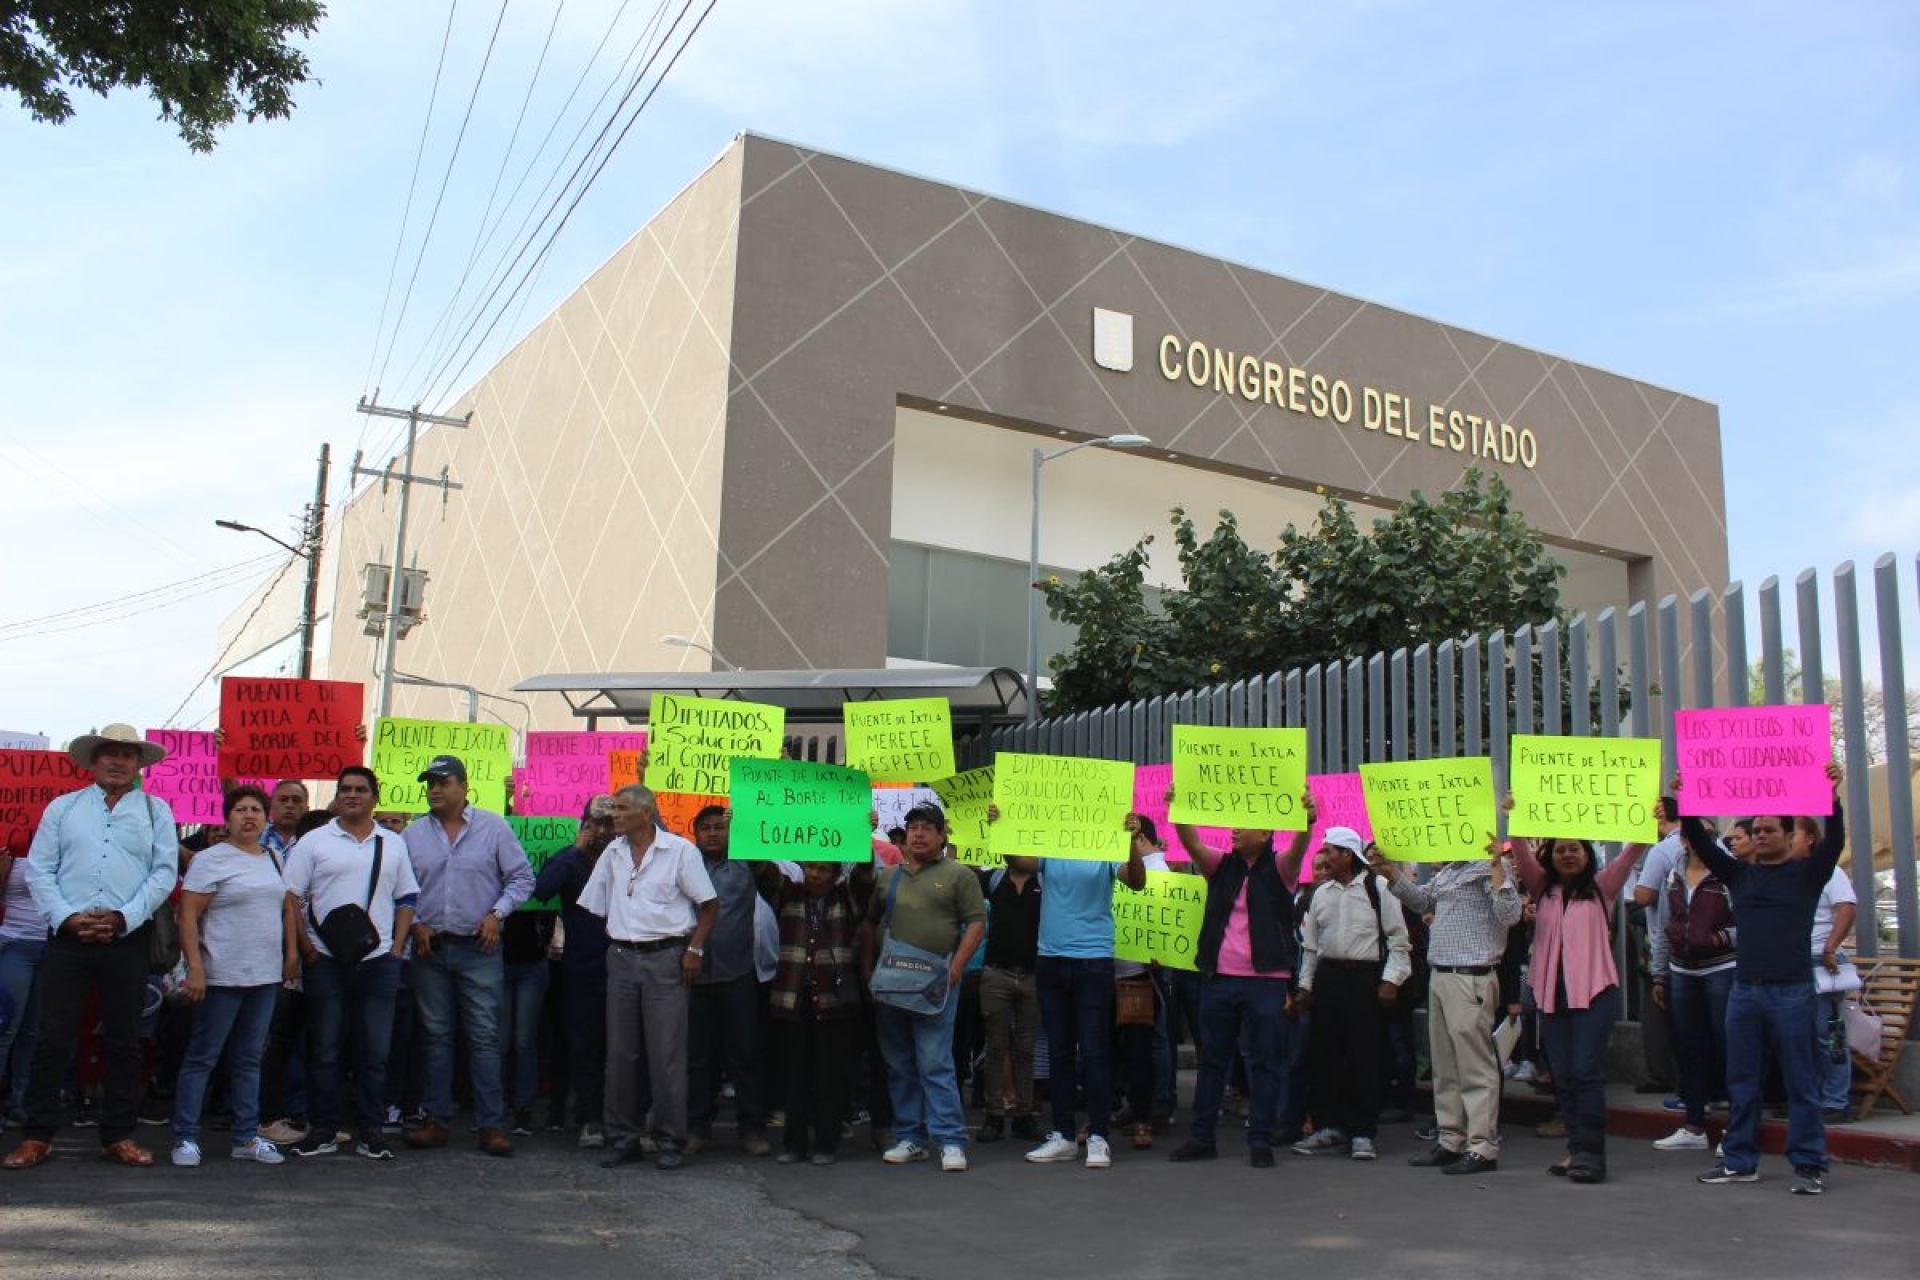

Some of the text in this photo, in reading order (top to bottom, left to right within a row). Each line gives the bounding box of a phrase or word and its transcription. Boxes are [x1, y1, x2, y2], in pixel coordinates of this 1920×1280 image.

[1159, 334, 1537, 468] CONGRESO DEL ESTADO
[236, 683, 304, 701] PUENTE
[240, 709, 332, 727] IXTLA AL
[851, 711, 892, 727] PUENTE
[1684, 717, 1711, 740] LOS
[1792, 716, 1815, 737] NO
[249, 731, 346, 750] BORDE DEL
[379, 721, 436, 748] PUENTE
[866, 730, 932, 750] MERECE
[529, 736, 578, 756] PUENTE
[586, 736, 606, 756] DE
[655, 745, 670, 767] al
[1178, 739, 1223, 756] PUENTE
[1250, 742, 1296, 758] IXTLA
[235, 754, 343, 775] COLAPSO
[374, 752, 395, 775] AL
[858, 751, 942, 773] RESPETO
[1012, 755, 1112, 780] DIPUTADOS
[1520, 747, 1575, 766] PUENTE
[1600, 750, 1648, 769] IXTLA
[553, 761, 607, 787] BORDE
[742, 766, 782, 783] PUENTE
[1199, 764, 1280, 787] MERECE
[1368, 776, 1409, 792] PUENTE
[1440, 774, 1481, 790] IXTLA
[1002, 779, 1084, 802] SOLUCION
[1097, 786, 1127, 806] AL
[1540, 773, 1638, 798] MERECE
[1697, 777, 1789, 798] DE SEGUNDA
[756, 789, 775, 806] AL
[784, 788, 826, 806] BORDE
[1188, 792, 1294, 816] RESPETO
[1386, 795, 1468, 819] MERECE
[1007, 803, 1106, 824] CONVENIO
[1528, 802, 1647, 827] RESPETO
[760, 821, 842, 847] COLAPSO
[1016, 829, 1120, 849] DE DEUDA
[1381, 822, 1475, 847] RESPETO
[1163, 881, 1201, 903] IXTLA
